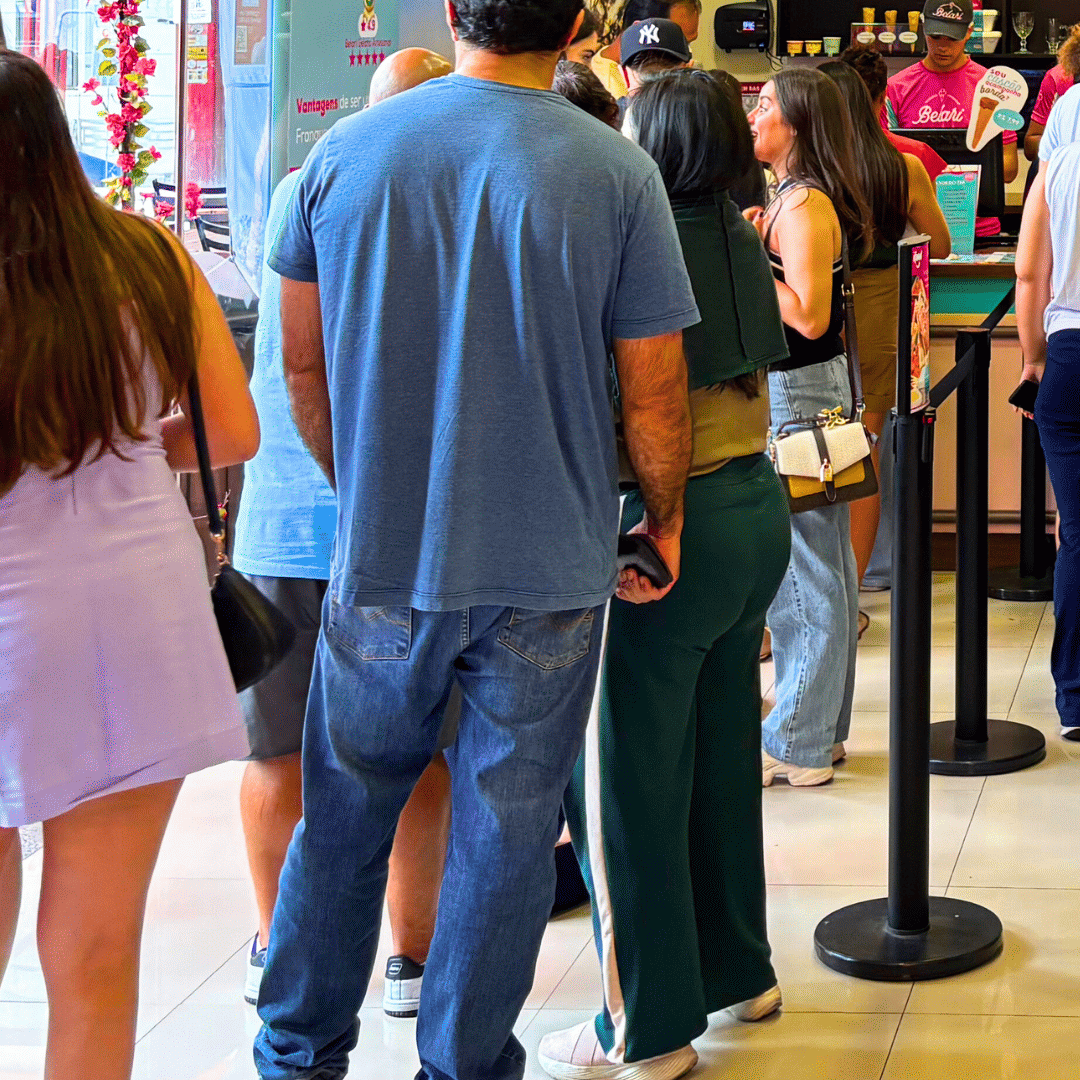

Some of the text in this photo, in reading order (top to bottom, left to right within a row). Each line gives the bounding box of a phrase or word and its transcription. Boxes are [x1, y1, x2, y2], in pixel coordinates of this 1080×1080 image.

[296, 97, 339, 117] Vantagens
[339, 94, 349, 109] de
[350, 96, 361, 109] ser
[911, 104, 965, 125] Belari
